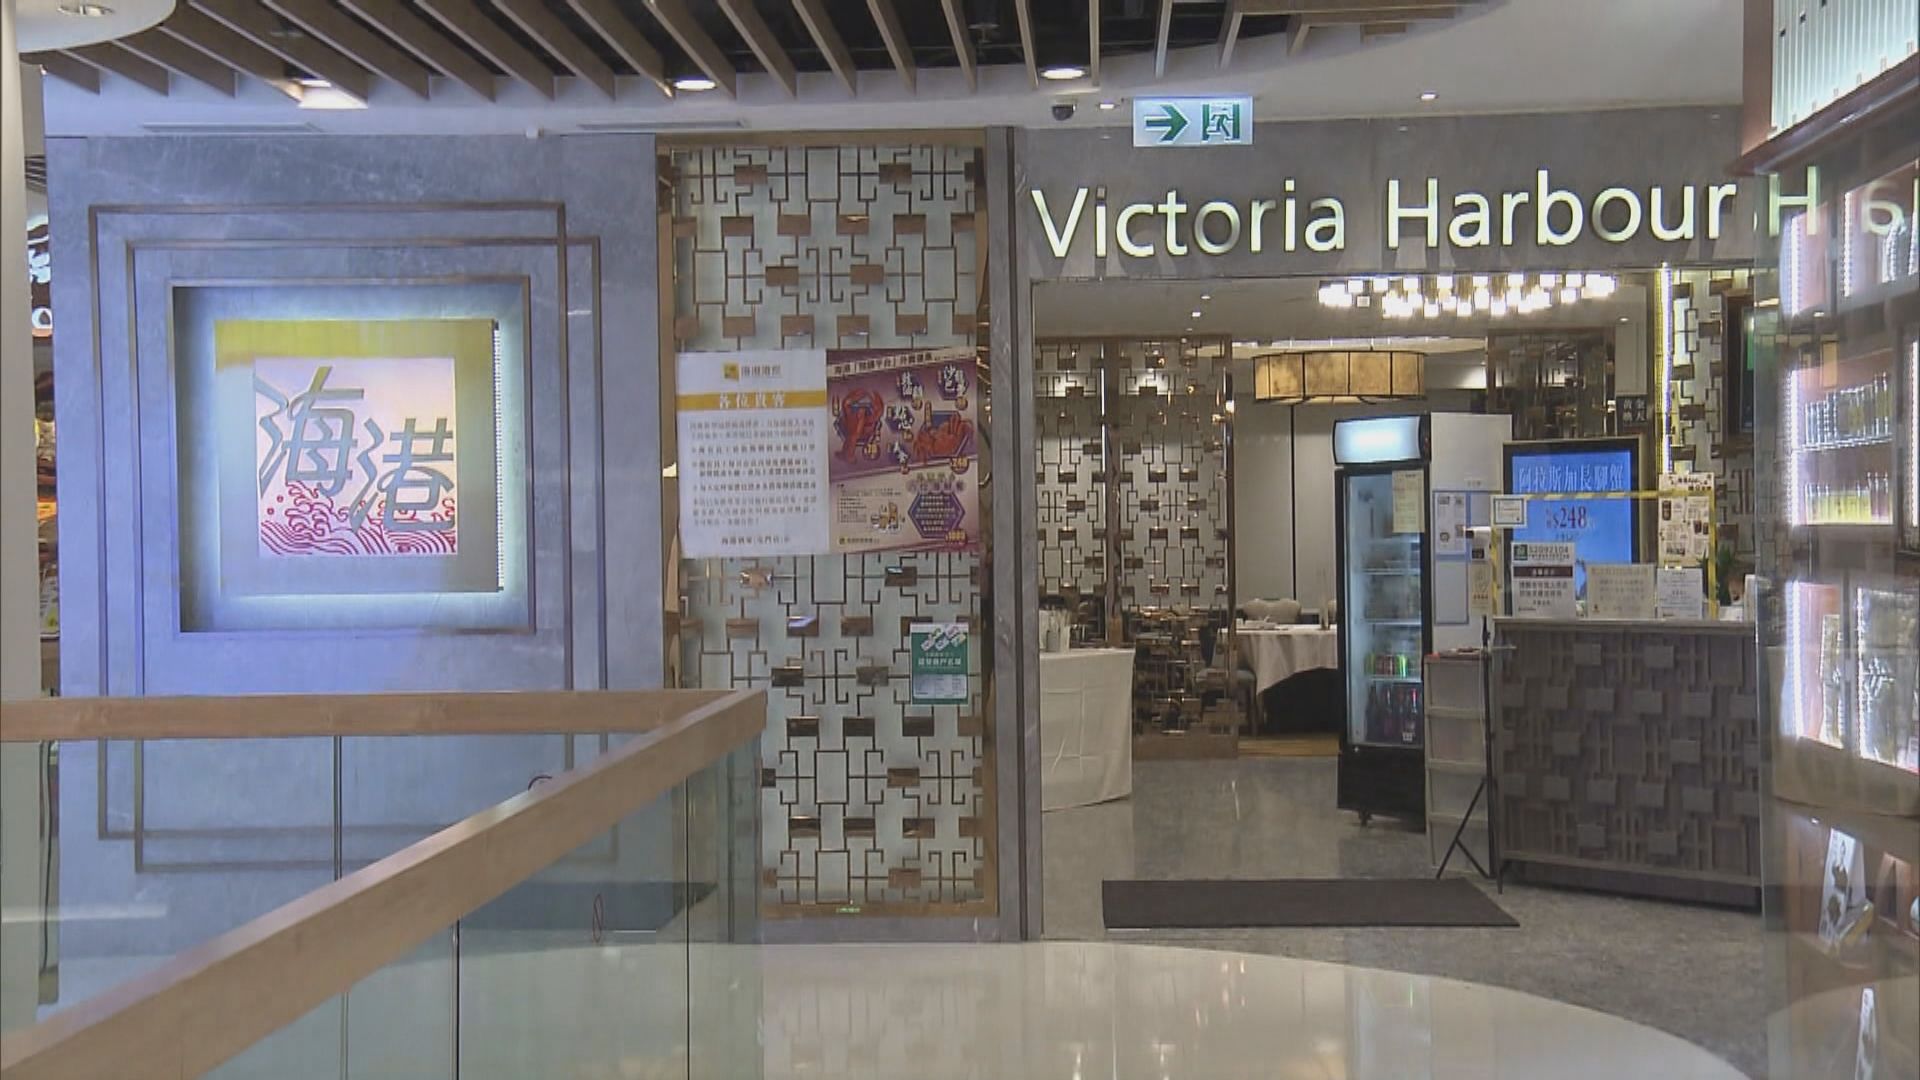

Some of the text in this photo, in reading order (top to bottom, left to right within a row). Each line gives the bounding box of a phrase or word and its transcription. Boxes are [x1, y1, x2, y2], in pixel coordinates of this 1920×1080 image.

[1031, 169, 1737, 259] Victoria Harbour
[254, 366, 456, 533] 海港
